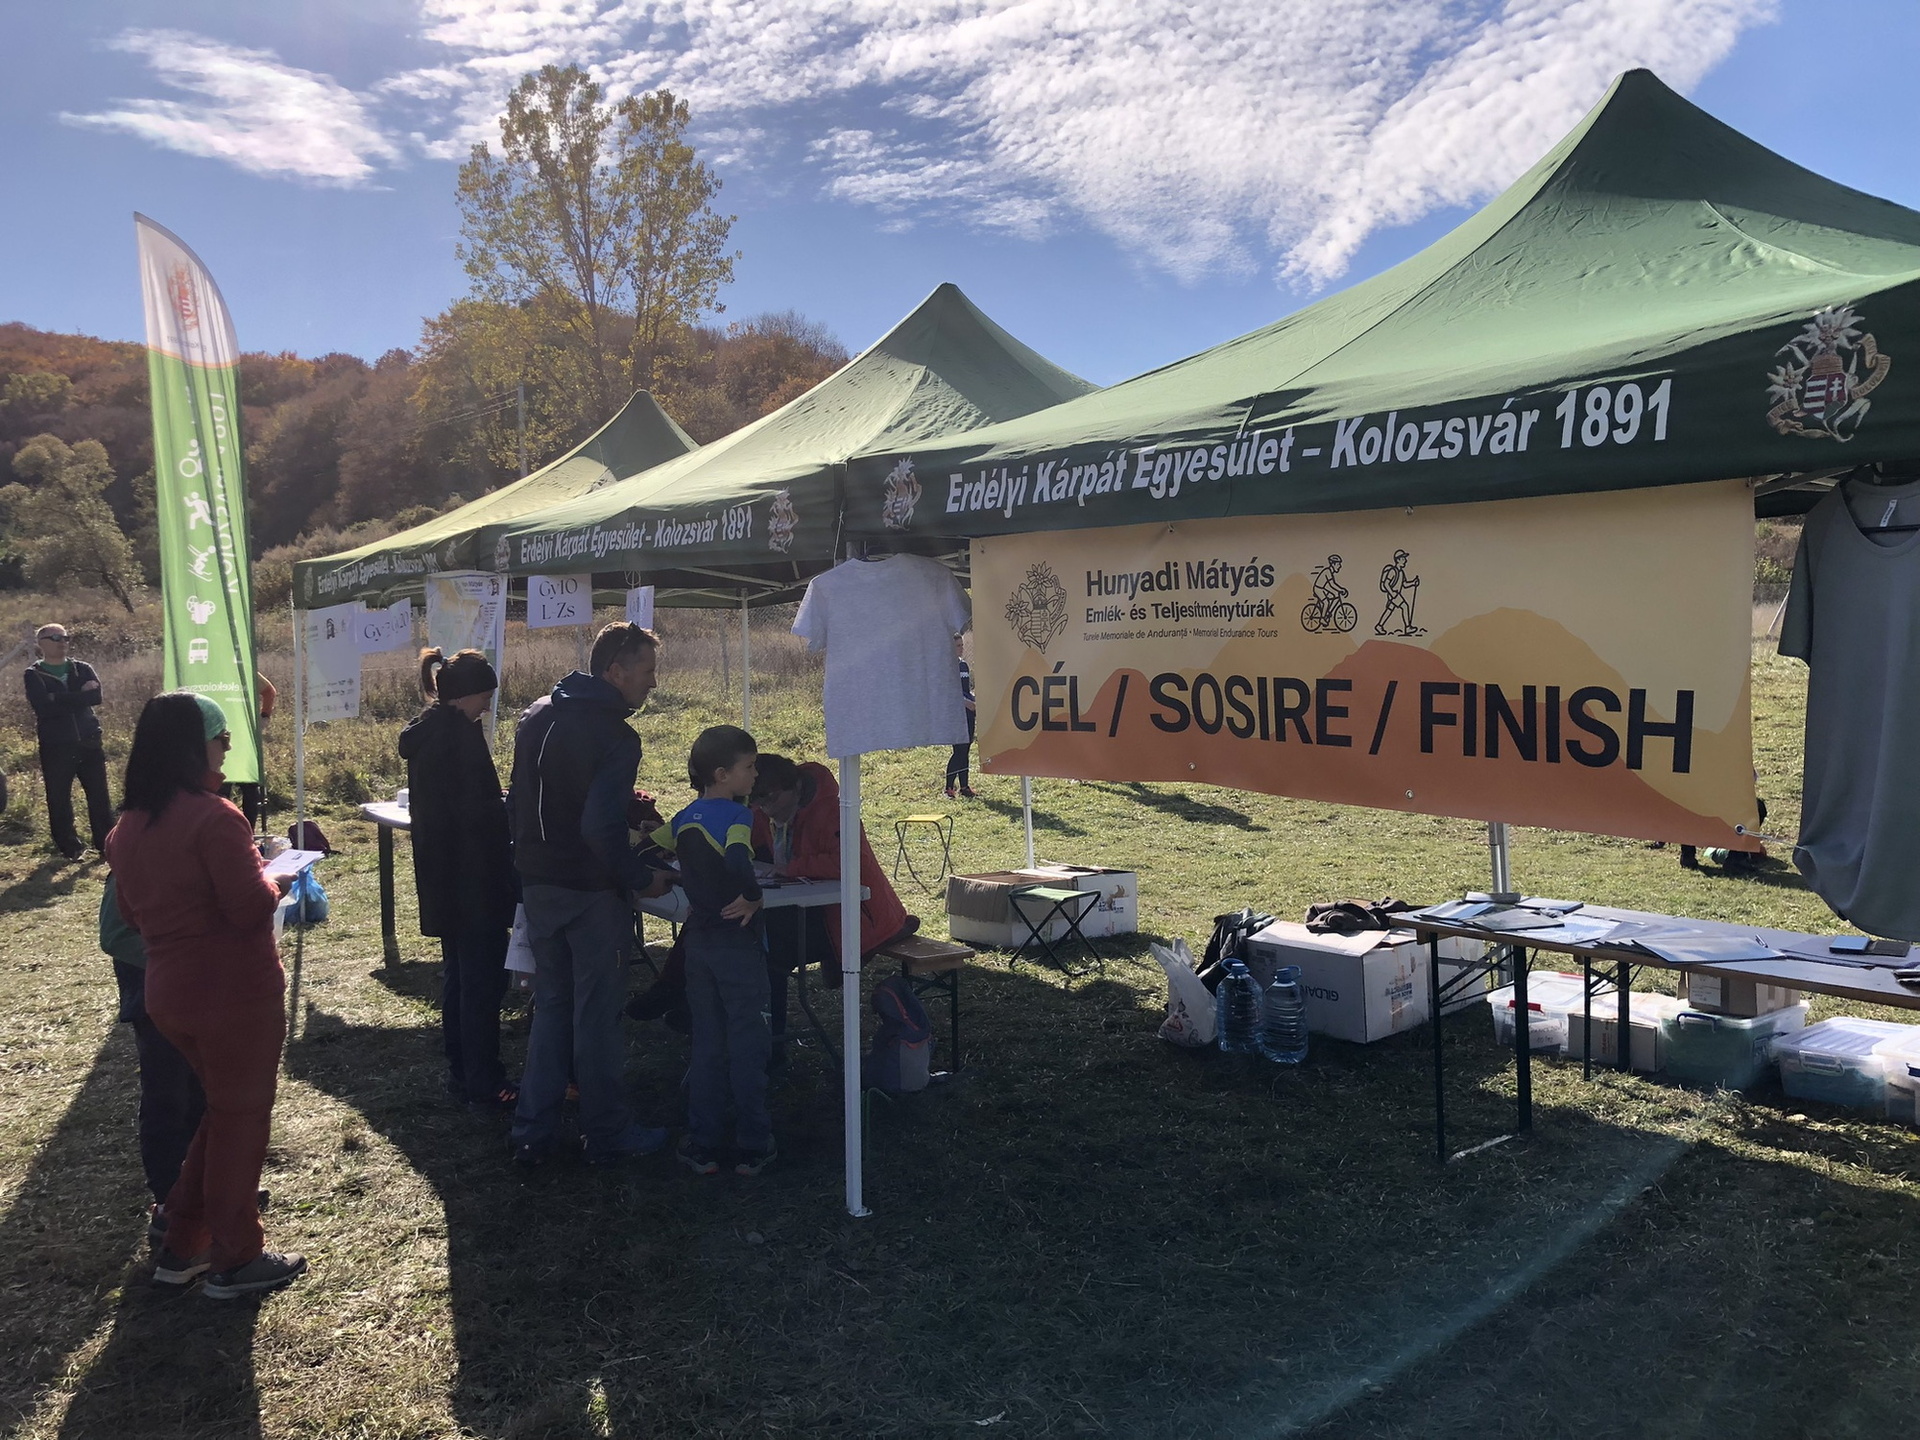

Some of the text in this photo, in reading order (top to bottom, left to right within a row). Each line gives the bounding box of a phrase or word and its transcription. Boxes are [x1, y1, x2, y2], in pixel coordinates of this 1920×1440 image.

[945, 464, 1029, 519] Erdélyi
[1032, 448, 1128, 508] Kárpát
[1131, 426, 1296, 500] Egyesület
[1329, 397, 1541, 469] Kolozsvár
[1555, 378, 1672, 449] 1891
[521, 534, 554, 565] Erdélyi
[555, 527, 591, 560] Kárpát
[591, 521, 646, 558] Egyesület
[653, 510, 718, 548] Kolozsvár
[722, 505, 753, 541] 1891
[1086, 556, 1275, 601] Hunyadi Mátyás
[1086, 605, 1126, 624] Emlék-
[1129, 603, 1147, 620] és
[1151, 599, 1275, 623] Teljesítménytúrák
[1135, 629, 1146, 639] de
[1192, 628, 1219, 638] Memorial
[1219, 628, 1255, 638] Endurance
[1257, 628, 1279, 638] Tours
[1011, 661, 1694, 774] CÉL / SOSIRE / FINISH
